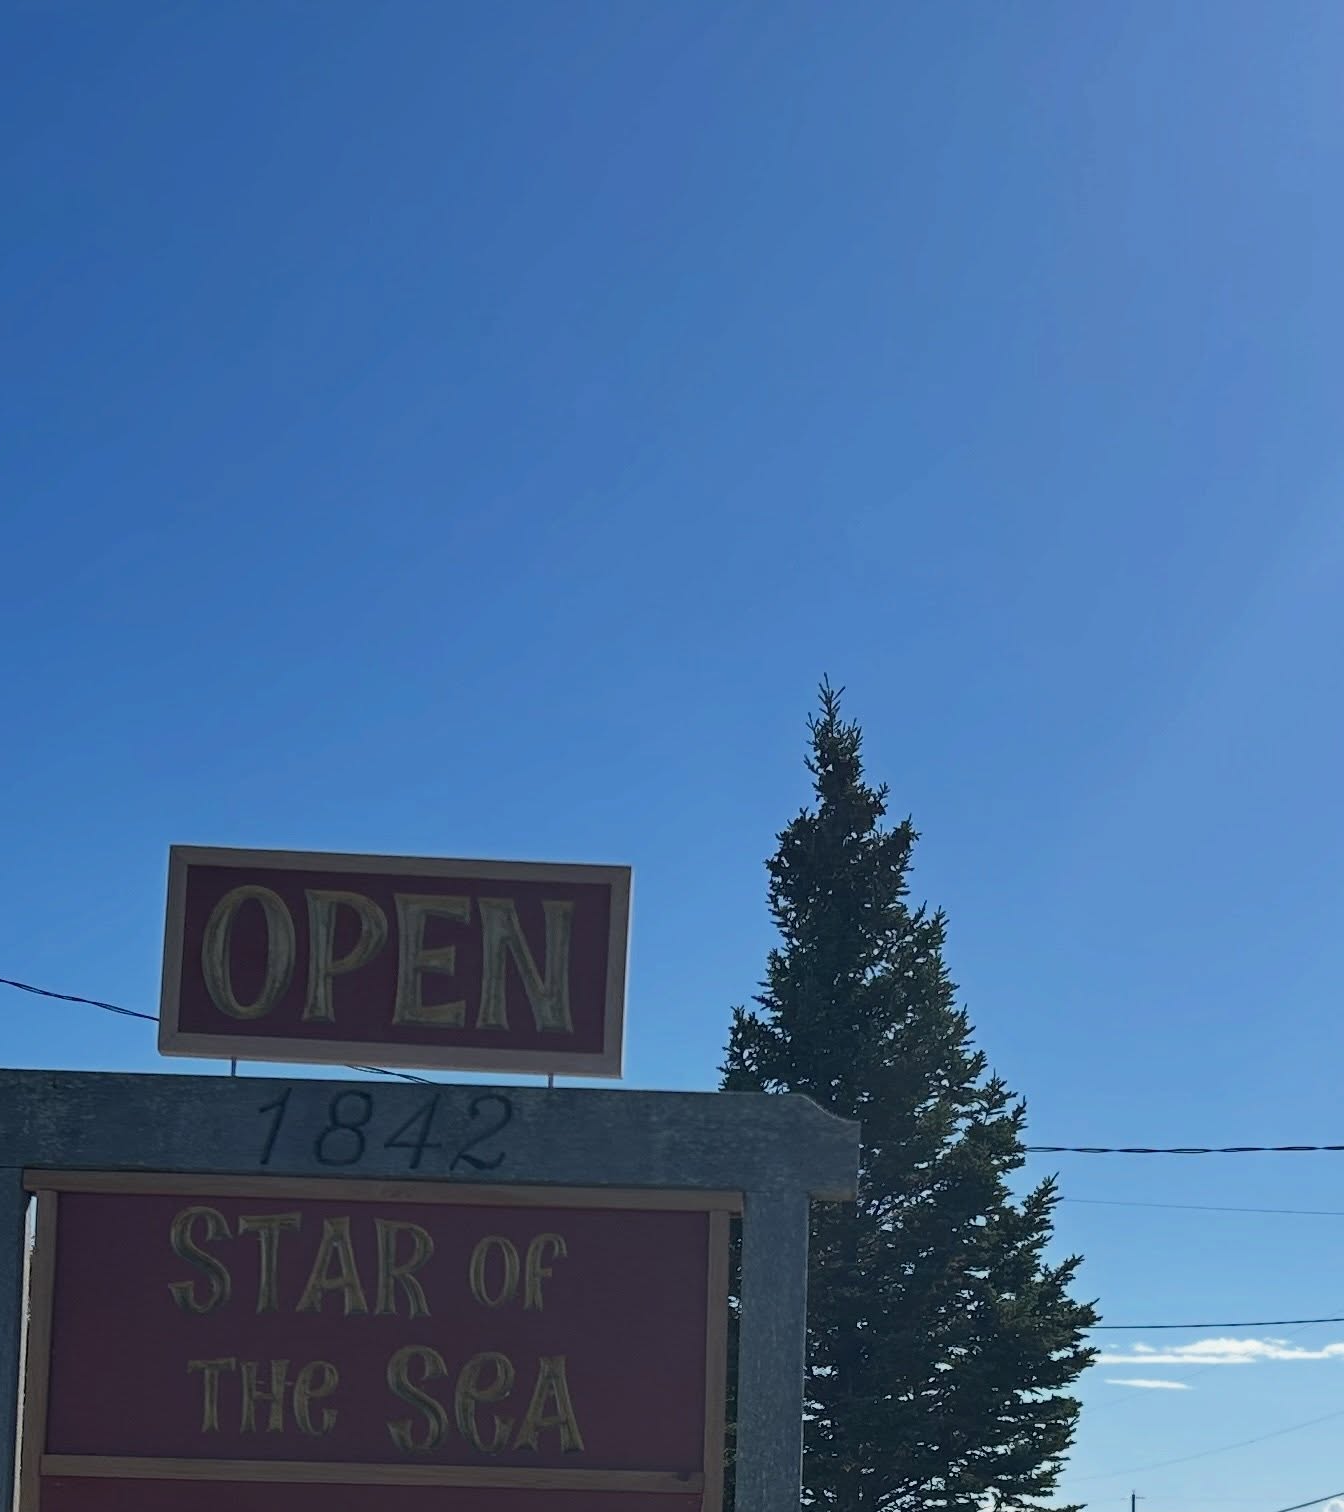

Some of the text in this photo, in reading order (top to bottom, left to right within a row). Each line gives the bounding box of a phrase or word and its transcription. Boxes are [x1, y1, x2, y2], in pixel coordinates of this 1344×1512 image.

[201, 884, 574, 1034] OPEN
[258, 1087, 513, 1171] 1842
[167, 1206, 435, 1319] STAR
